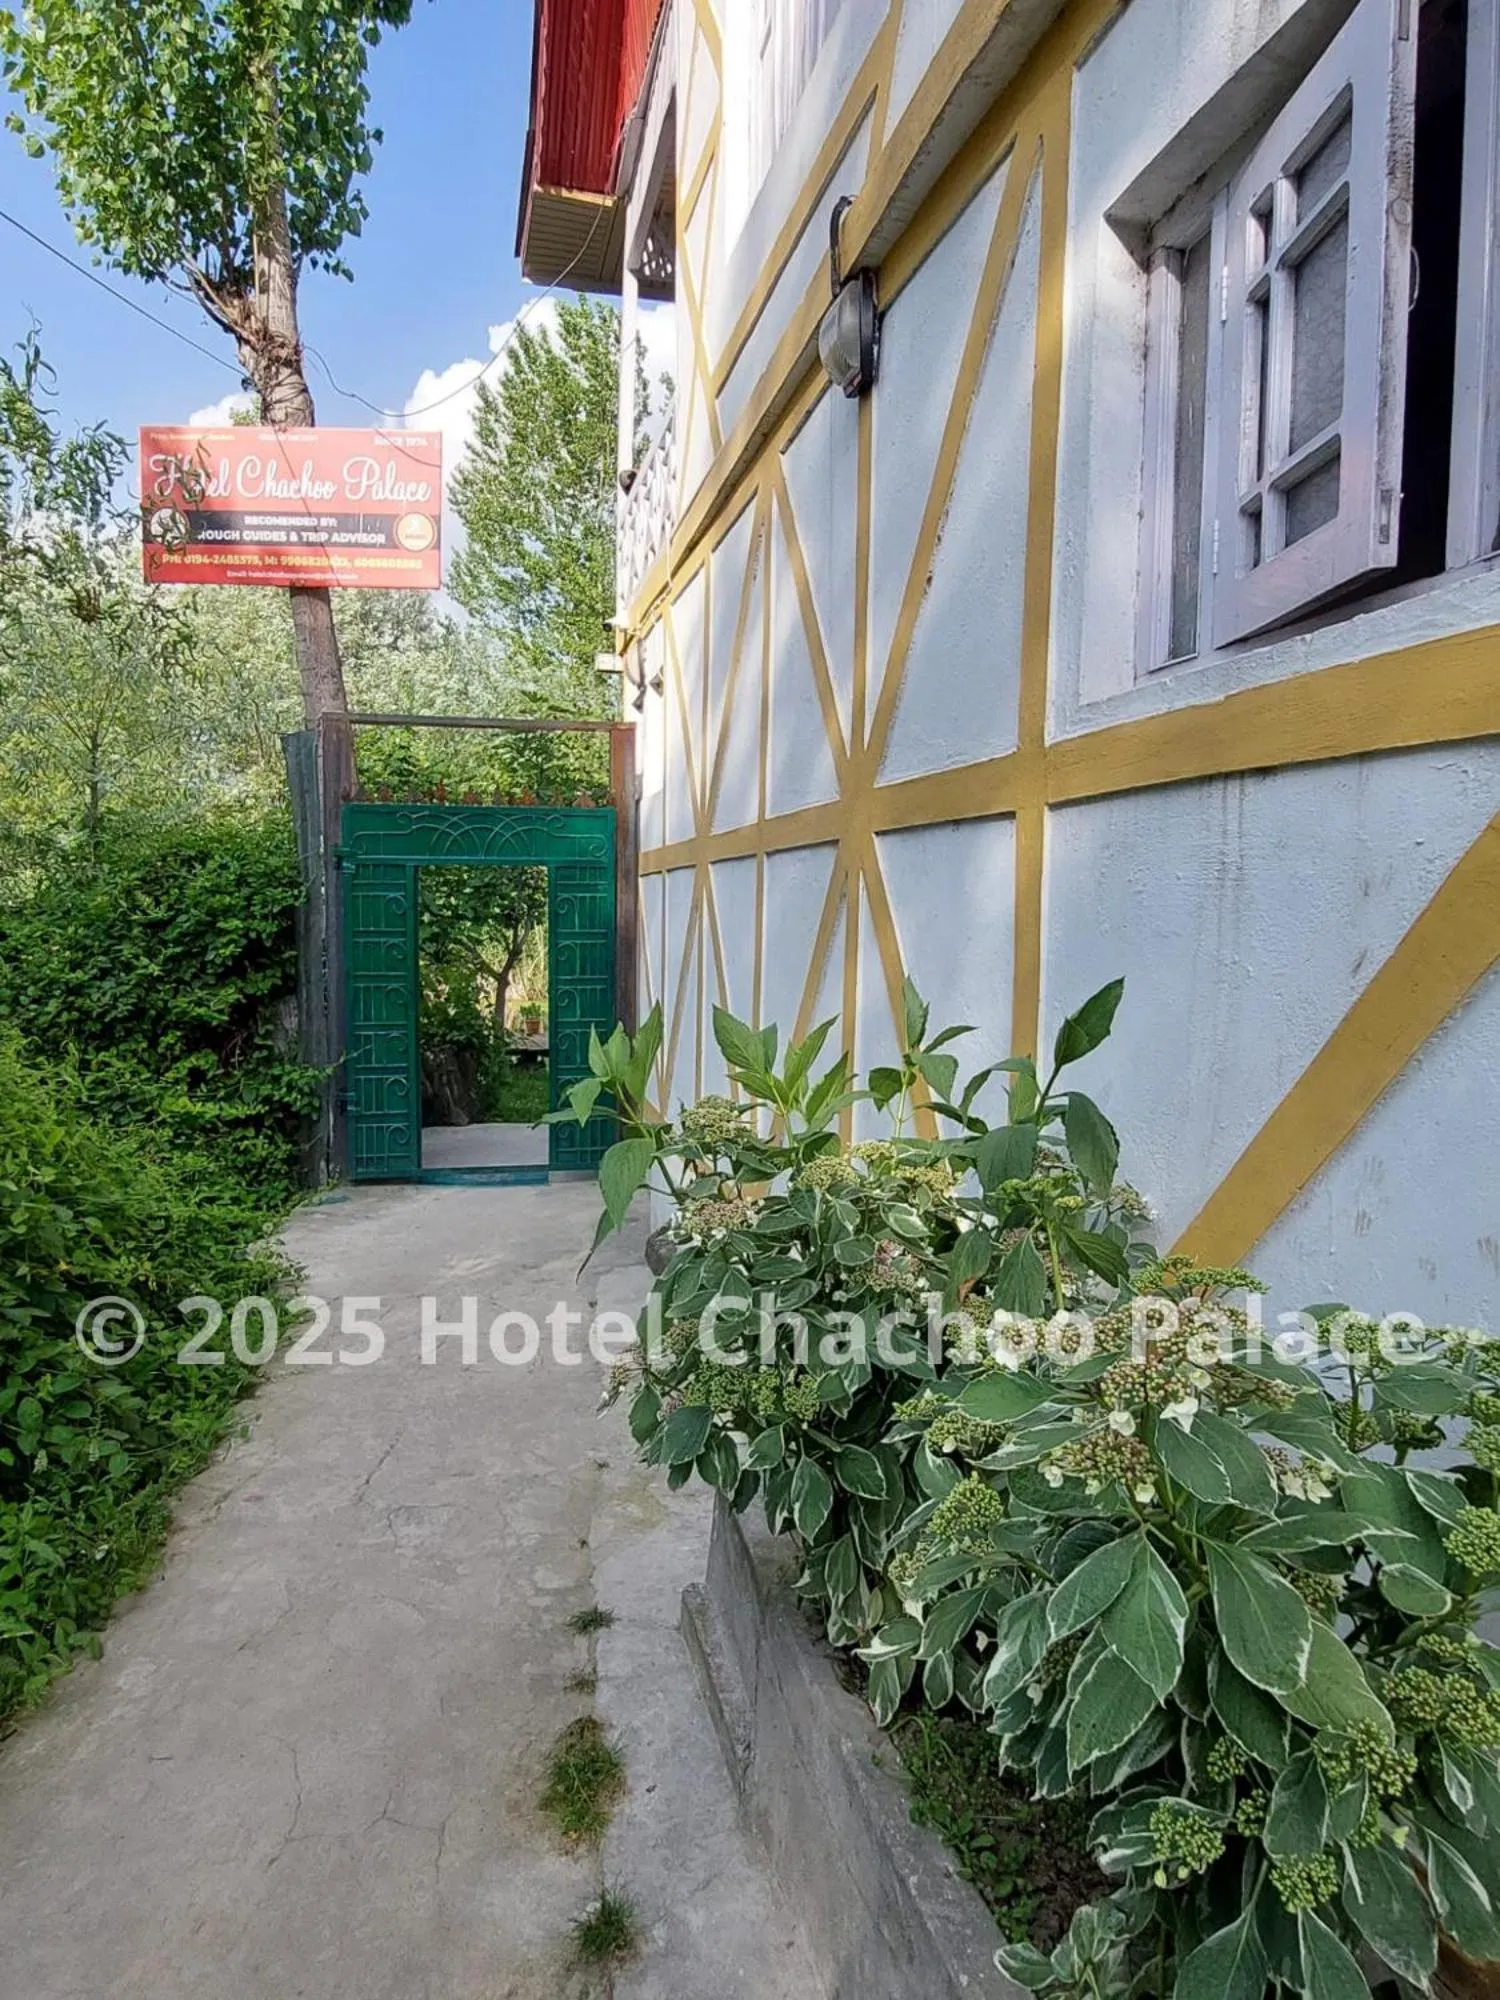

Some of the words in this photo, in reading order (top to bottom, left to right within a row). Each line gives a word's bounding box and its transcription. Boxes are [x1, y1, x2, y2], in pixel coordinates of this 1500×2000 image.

[237, 455, 338, 500] Chachoo
[343, 456, 432, 501] Palace
[242, 530, 287, 542] GUIDES
[289, 532, 298, 542] &
[300, 532, 328, 543] TRIP
[331, 532, 386, 545] ADVISOR
